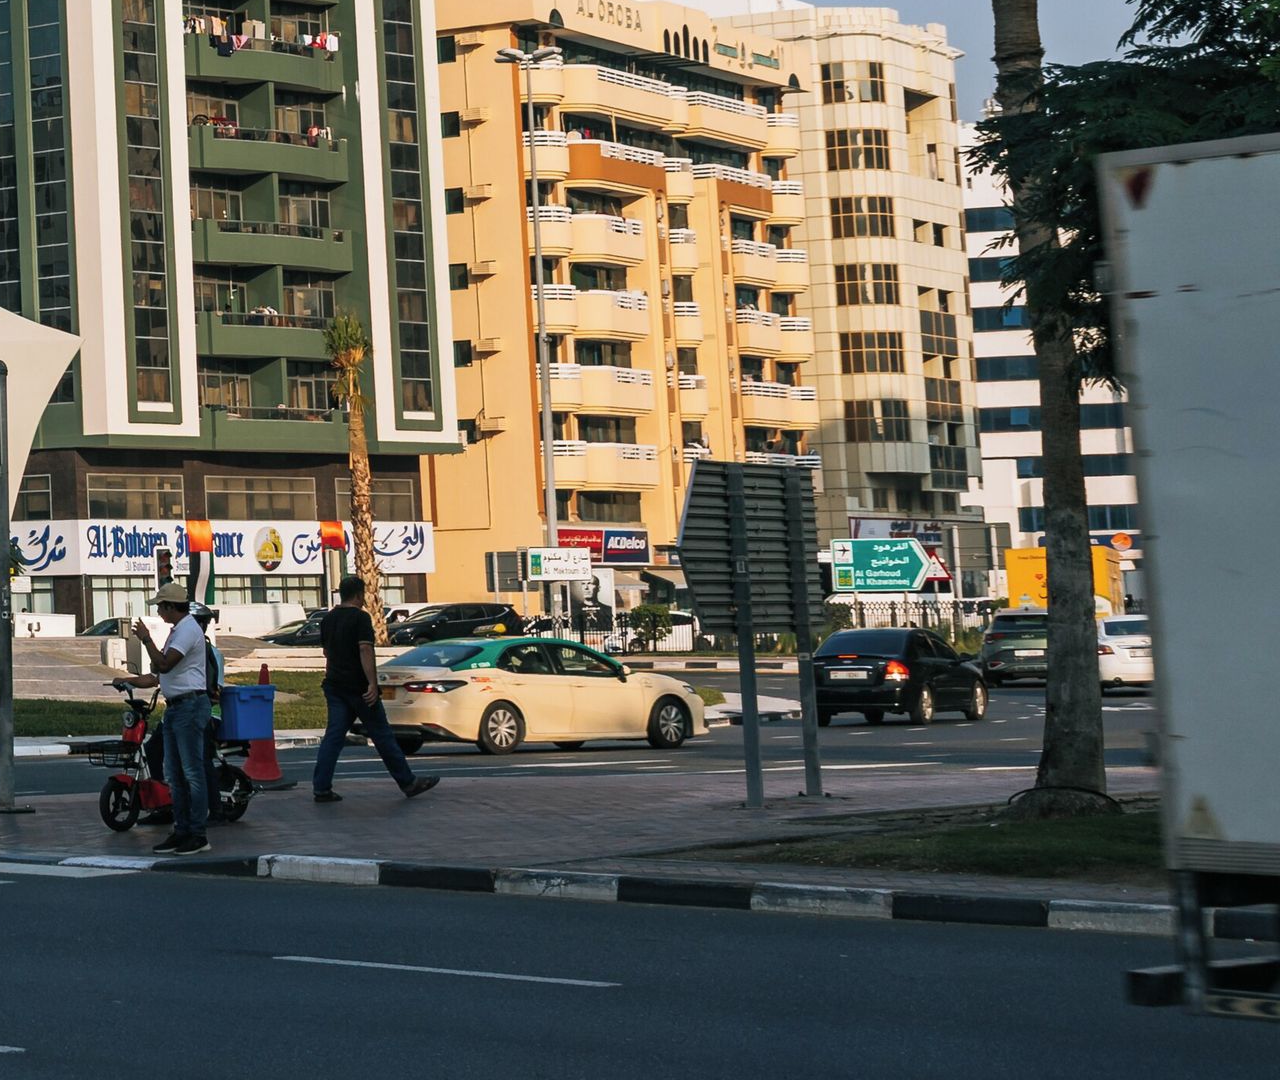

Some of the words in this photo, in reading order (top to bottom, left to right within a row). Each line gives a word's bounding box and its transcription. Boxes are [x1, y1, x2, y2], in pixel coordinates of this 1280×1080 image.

[597, 0, 643, 33] OROBA
[607, 536, 646, 549] ACDelco
[865, 569, 901, 577] Garhoud
[866, 577, 910, 586] Khawaneej
